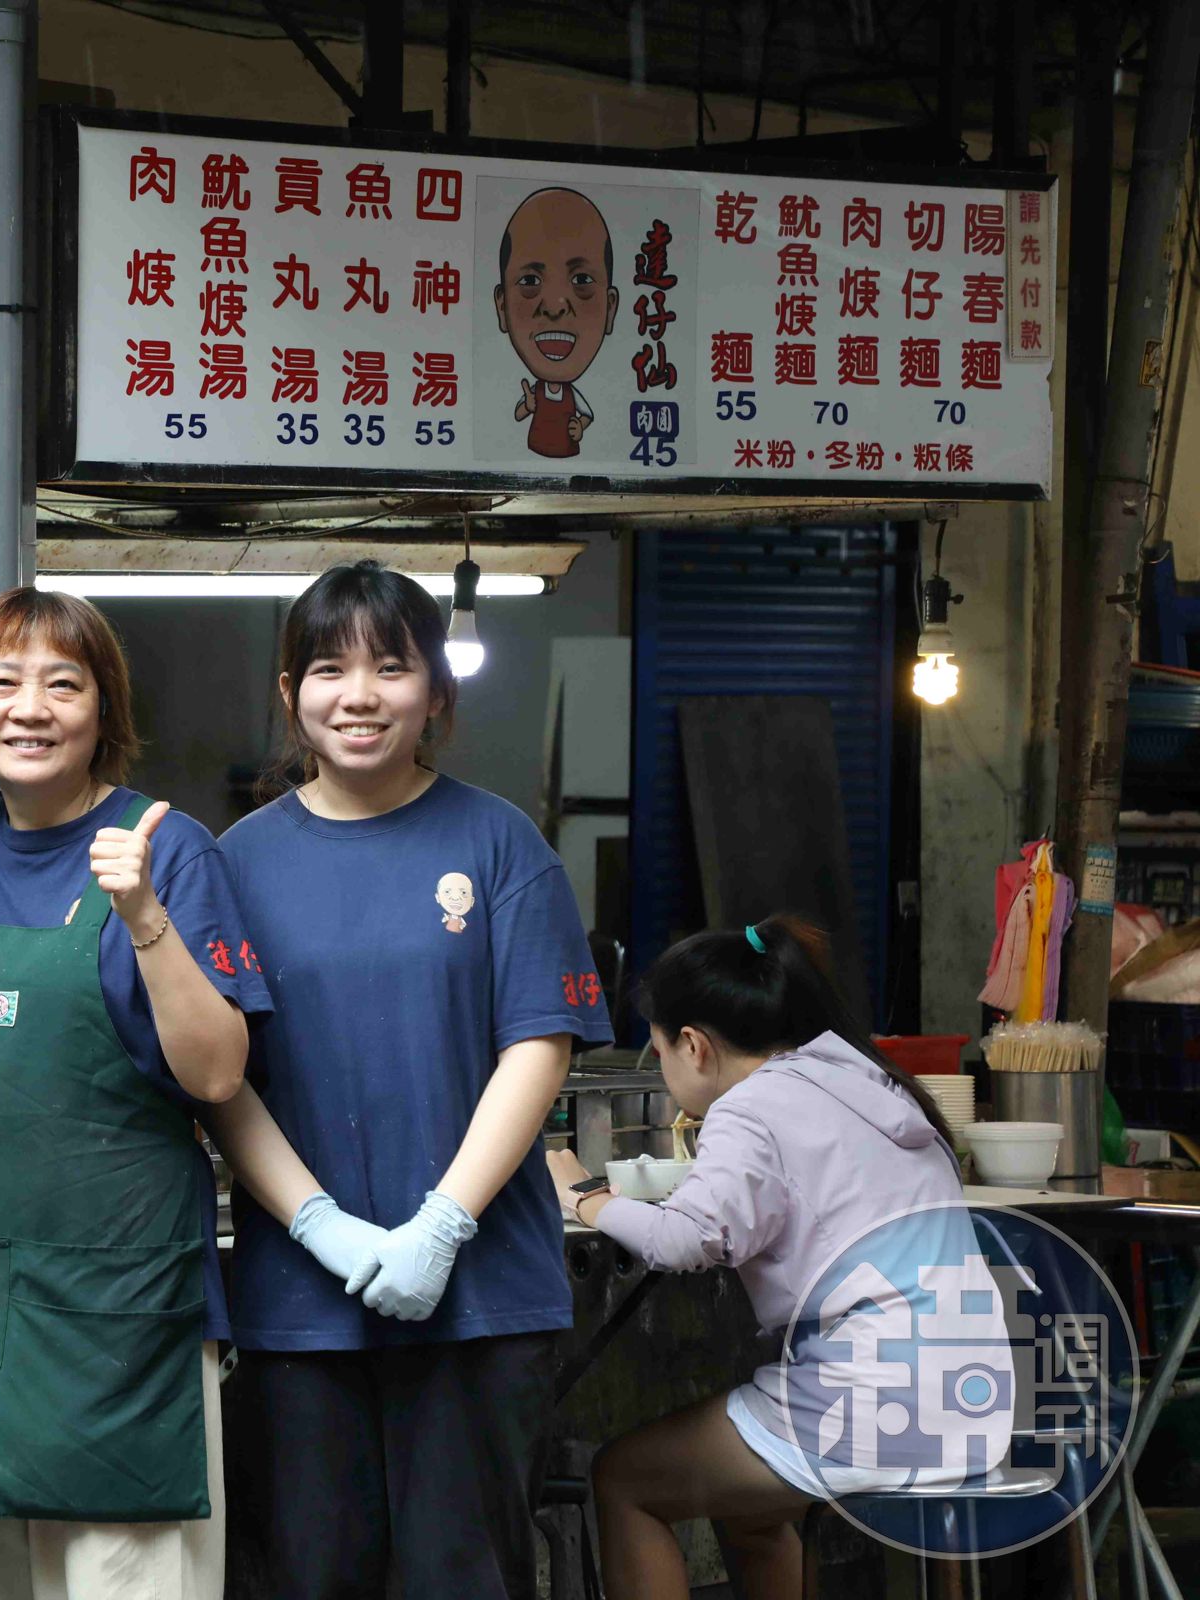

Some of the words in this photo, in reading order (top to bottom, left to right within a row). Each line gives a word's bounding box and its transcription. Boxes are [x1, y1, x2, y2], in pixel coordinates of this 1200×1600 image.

[271, 157, 323, 404] 貢丸湯
[341, 163, 392, 406] 魚丸湯
[412, 167, 463, 407] 四神湯
[710, 190, 758, 384] 乾麵
[1019, 191, 1043, 351] 請先付款
[633, 218, 679, 393] 達仔仙
[900, 200, 945, 389] 切仔麵
[961, 203, 1007, 391] 陽春麵
[636, 404, 673, 434] 肉圓
[715, 390, 758, 421] 55
[813, 400, 849, 426] 70
[933, 399, 967, 425] 70
[164, 413, 208, 439] 55
[276, 412, 320, 446] 35
[343, 413, 387, 446] 35
[414, 420, 456, 446] 55
[629, 434, 678, 467] 45
